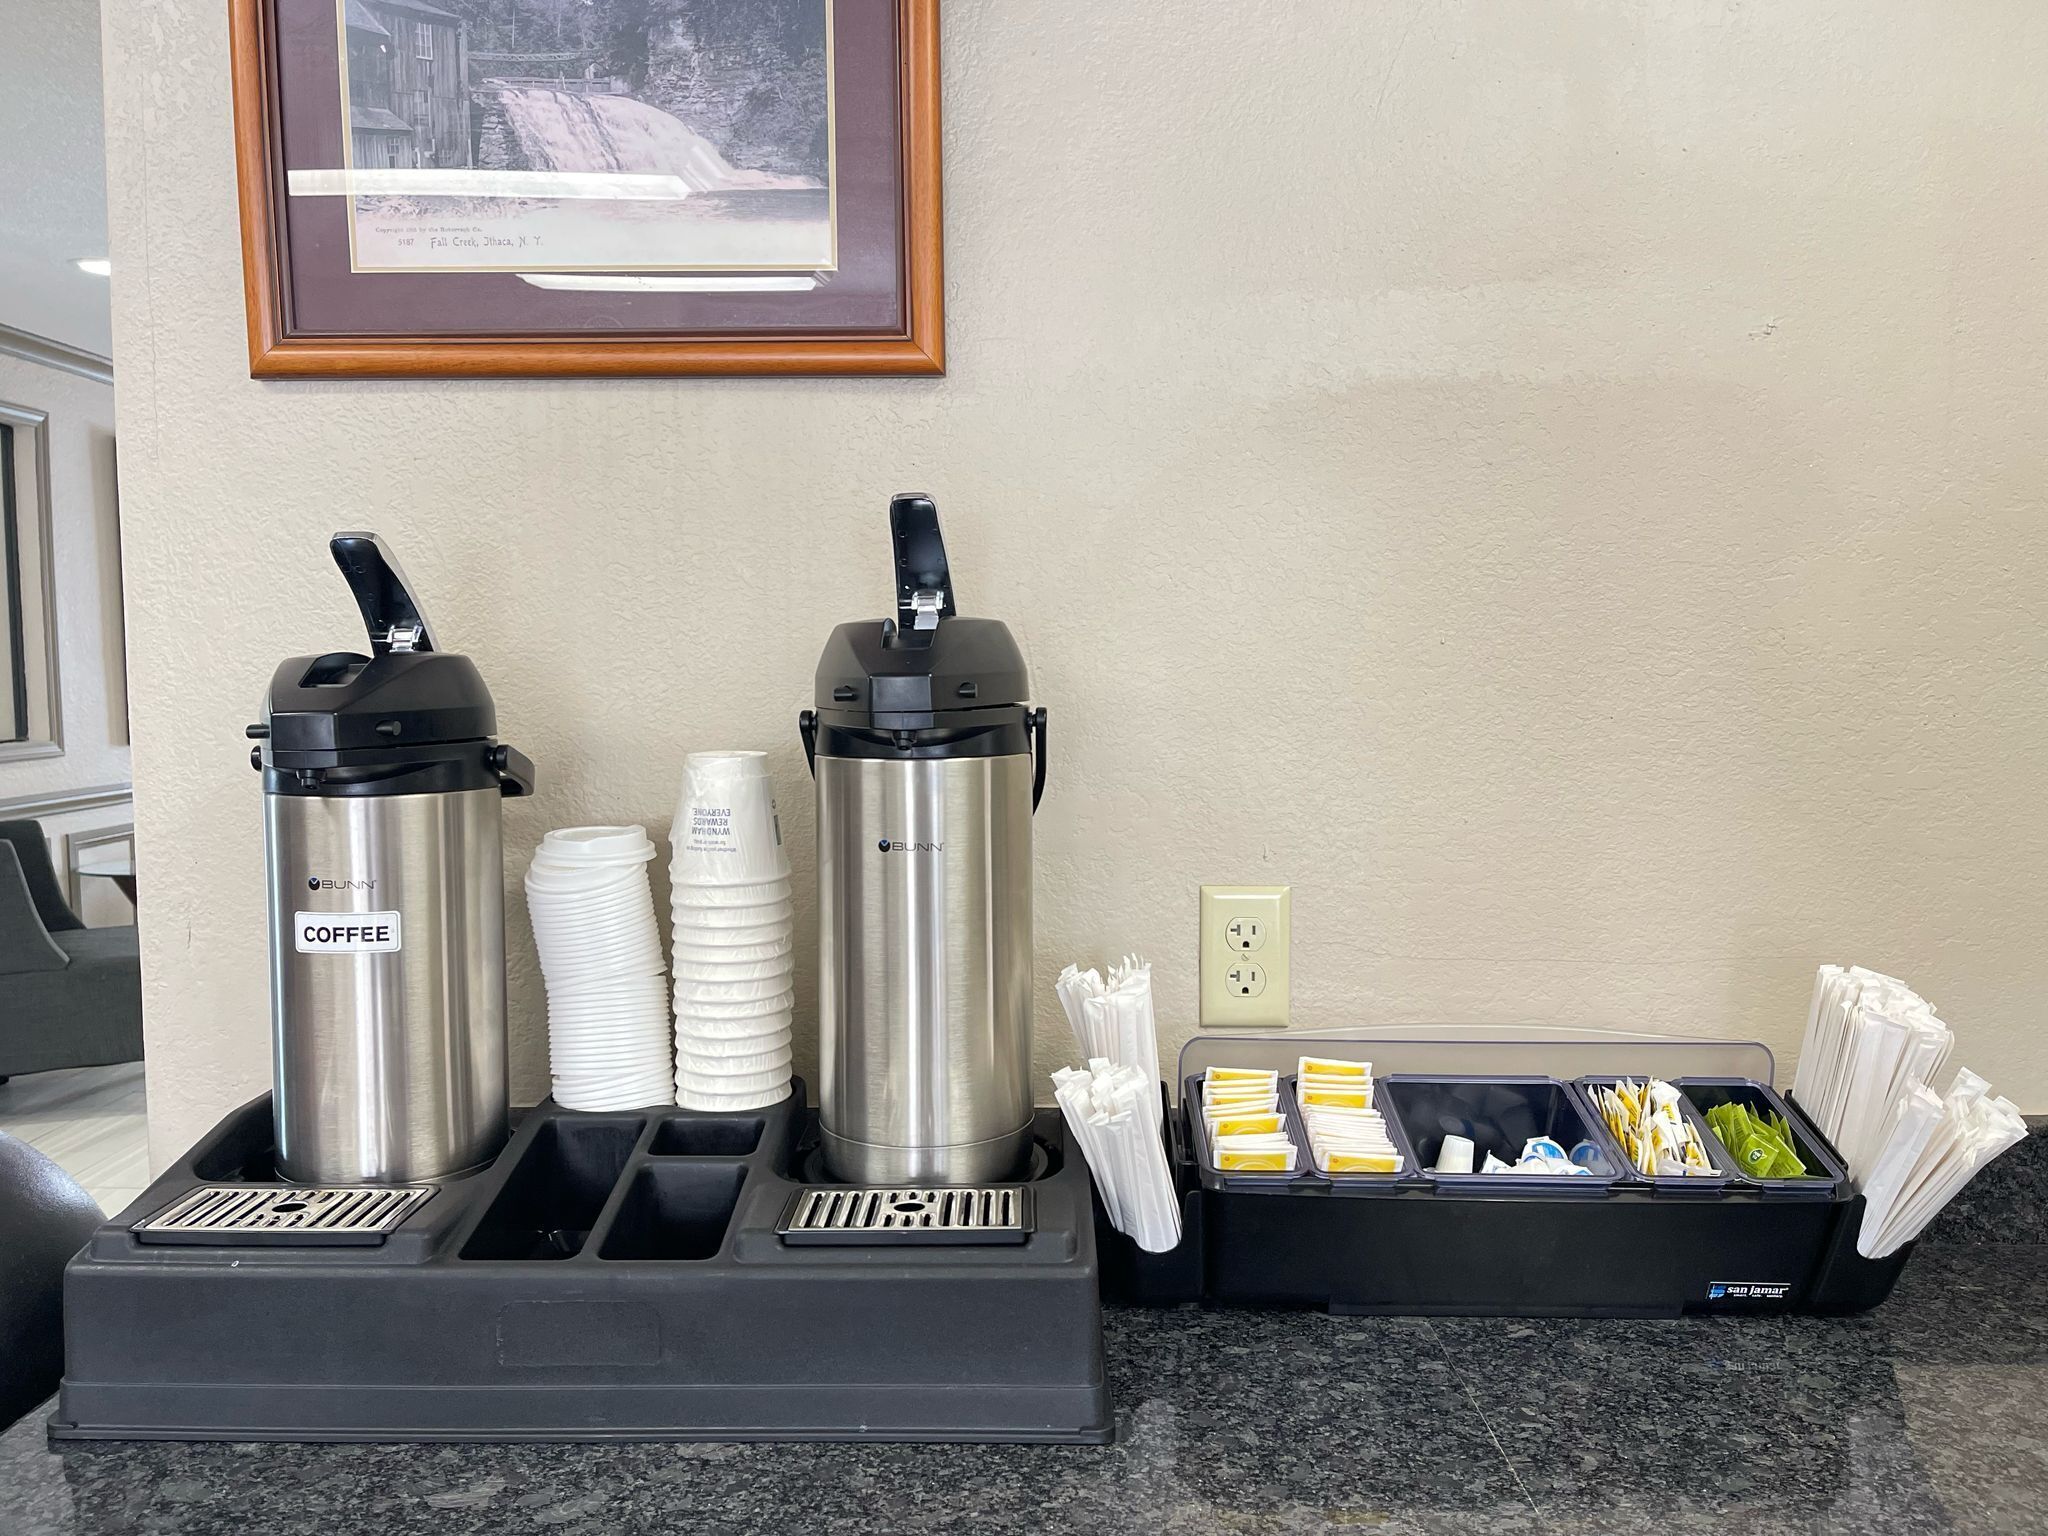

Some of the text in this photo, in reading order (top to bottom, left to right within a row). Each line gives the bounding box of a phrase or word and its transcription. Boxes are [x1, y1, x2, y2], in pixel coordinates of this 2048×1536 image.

[398, 238, 415, 247] 5187
[430, 236, 448, 249] Fall
[452, 236, 479, 248] Creek,
[693, 817, 728, 826] REWARDS
[691, 826, 731, 836] WYNDHAM
[892, 841, 943, 852] BUNN
[321, 879, 375, 890] BUNN
[303, 925, 390, 943] COFFEE
[1726, 1286, 1748, 1294] san
[1748, 1285, 1789, 1296] jamar
